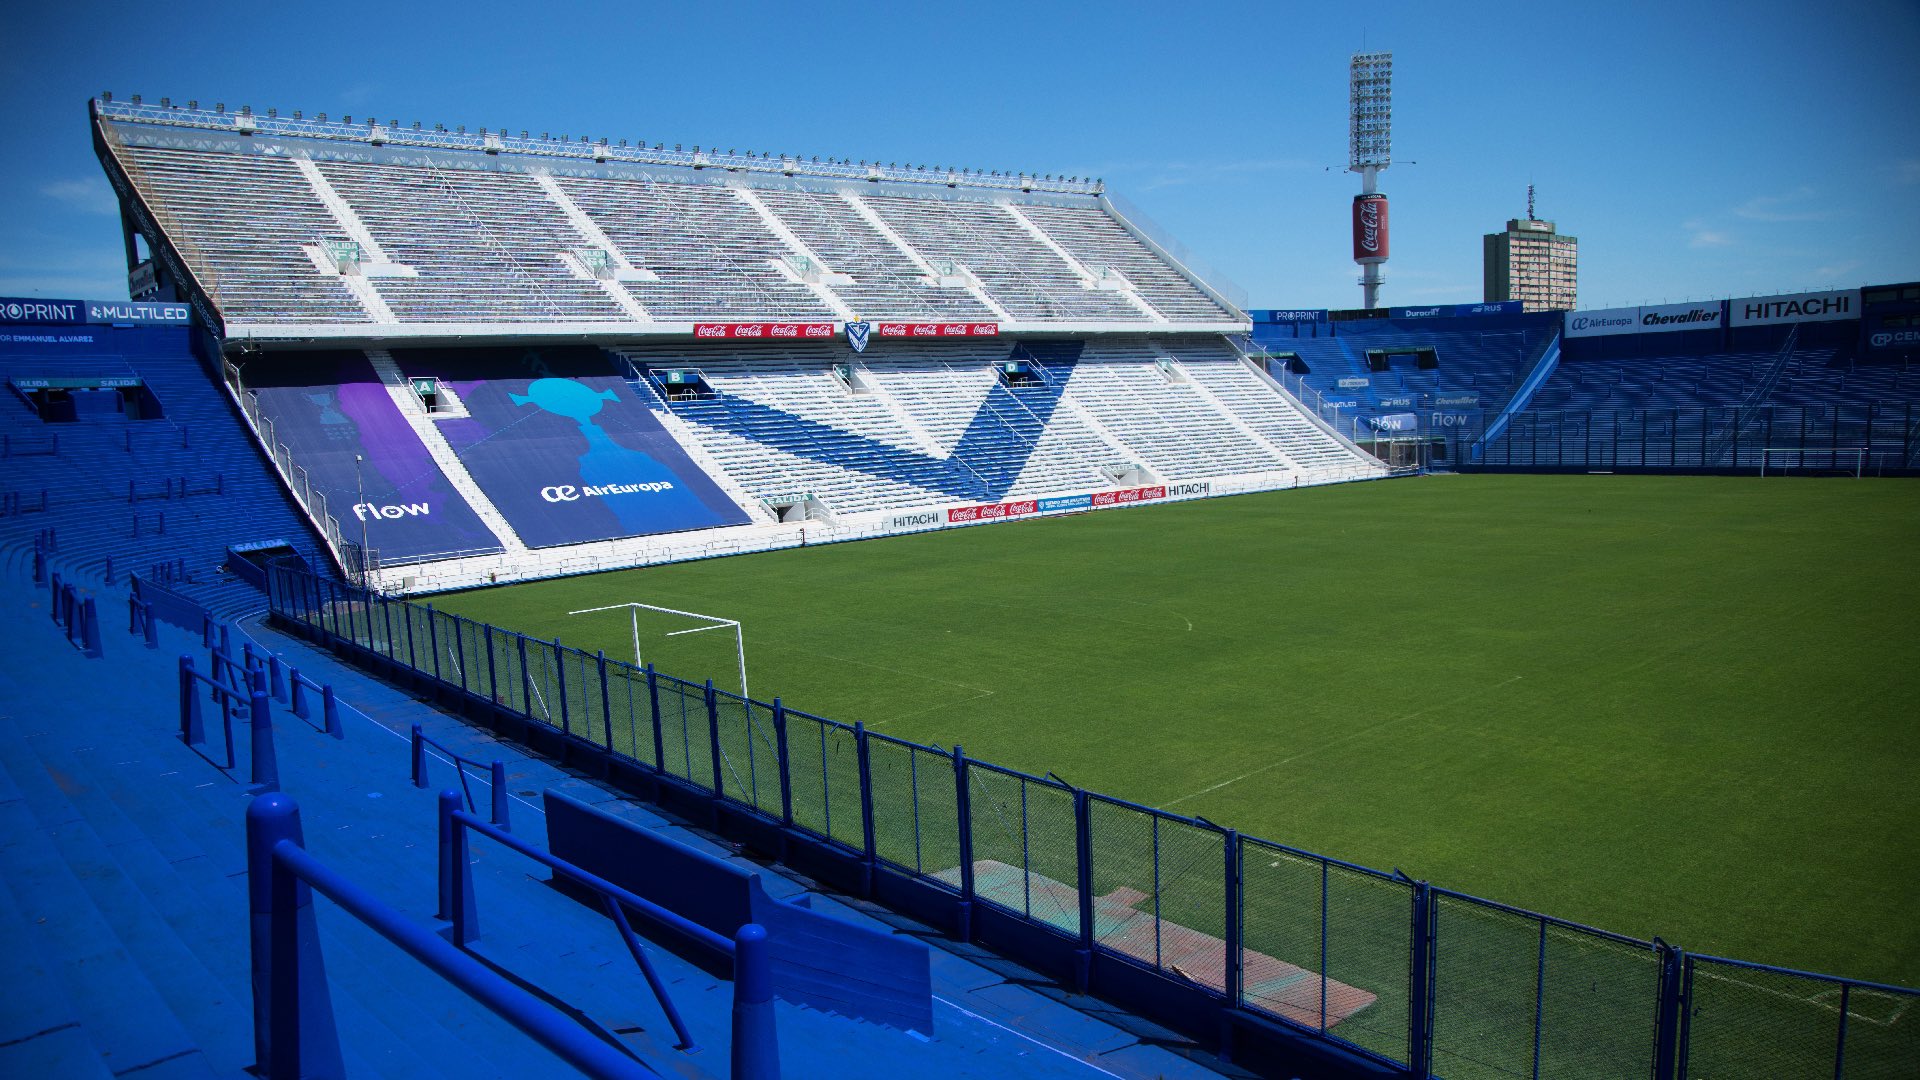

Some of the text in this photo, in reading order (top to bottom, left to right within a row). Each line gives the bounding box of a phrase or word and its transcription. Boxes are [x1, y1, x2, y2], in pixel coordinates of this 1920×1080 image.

[104, 306, 188, 320] MULTILED
[1484, 304, 1502, 312] RUS
[1744, 296, 1849, 320] HITACHI
[1276, 311, 1320, 321] PROPRINT
[1642, 309, 1720, 326] Chevallier
[1589, 317, 1632, 328] AirEuropa
[698, 325, 727, 337] Coca-Cola
[735, 325, 764, 337] Coca-Cola
[771, 325, 798, 337] Coca-Cola
[805, 325, 832, 337] Coca-Cola
[882, 324, 907, 336] Coca-Cola
[914, 324, 937, 336] Coca-Cola
[944, 324, 967, 336] Coca-Cola
[973, 324, 996, 336] Coca-Cola
[13, 334, 57, 343] EMMANUEL
[59, 335, 94, 343] ALVAREZ
[1007, 363, 1016, 372] D
[671, 372, 681, 382] B
[100, 379, 137, 388] SALIDA
[419, 381, 431, 392] A
[1392, 398, 1411, 406] RUS
[1432, 412, 1468, 427] flow
[581, 481, 673, 498] AirEuropa
[1143, 487, 1163, 500] Coca-Cola
[1168, 483, 1210, 497] HITACHI
[1094, 492, 1117, 505] Coca-Cola
[1118, 490, 1140, 502] Coca-Cola
[352, 502, 430, 522] flow
[981, 504, 1006, 518] Coca-Cola
[1010, 501, 1034, 515] Coca-Cola
[893, 512, 939, 528] HITACHI
[952, 508, 977, 521] Coca-Cola
[235, 539, 286, 552] SALIDA
